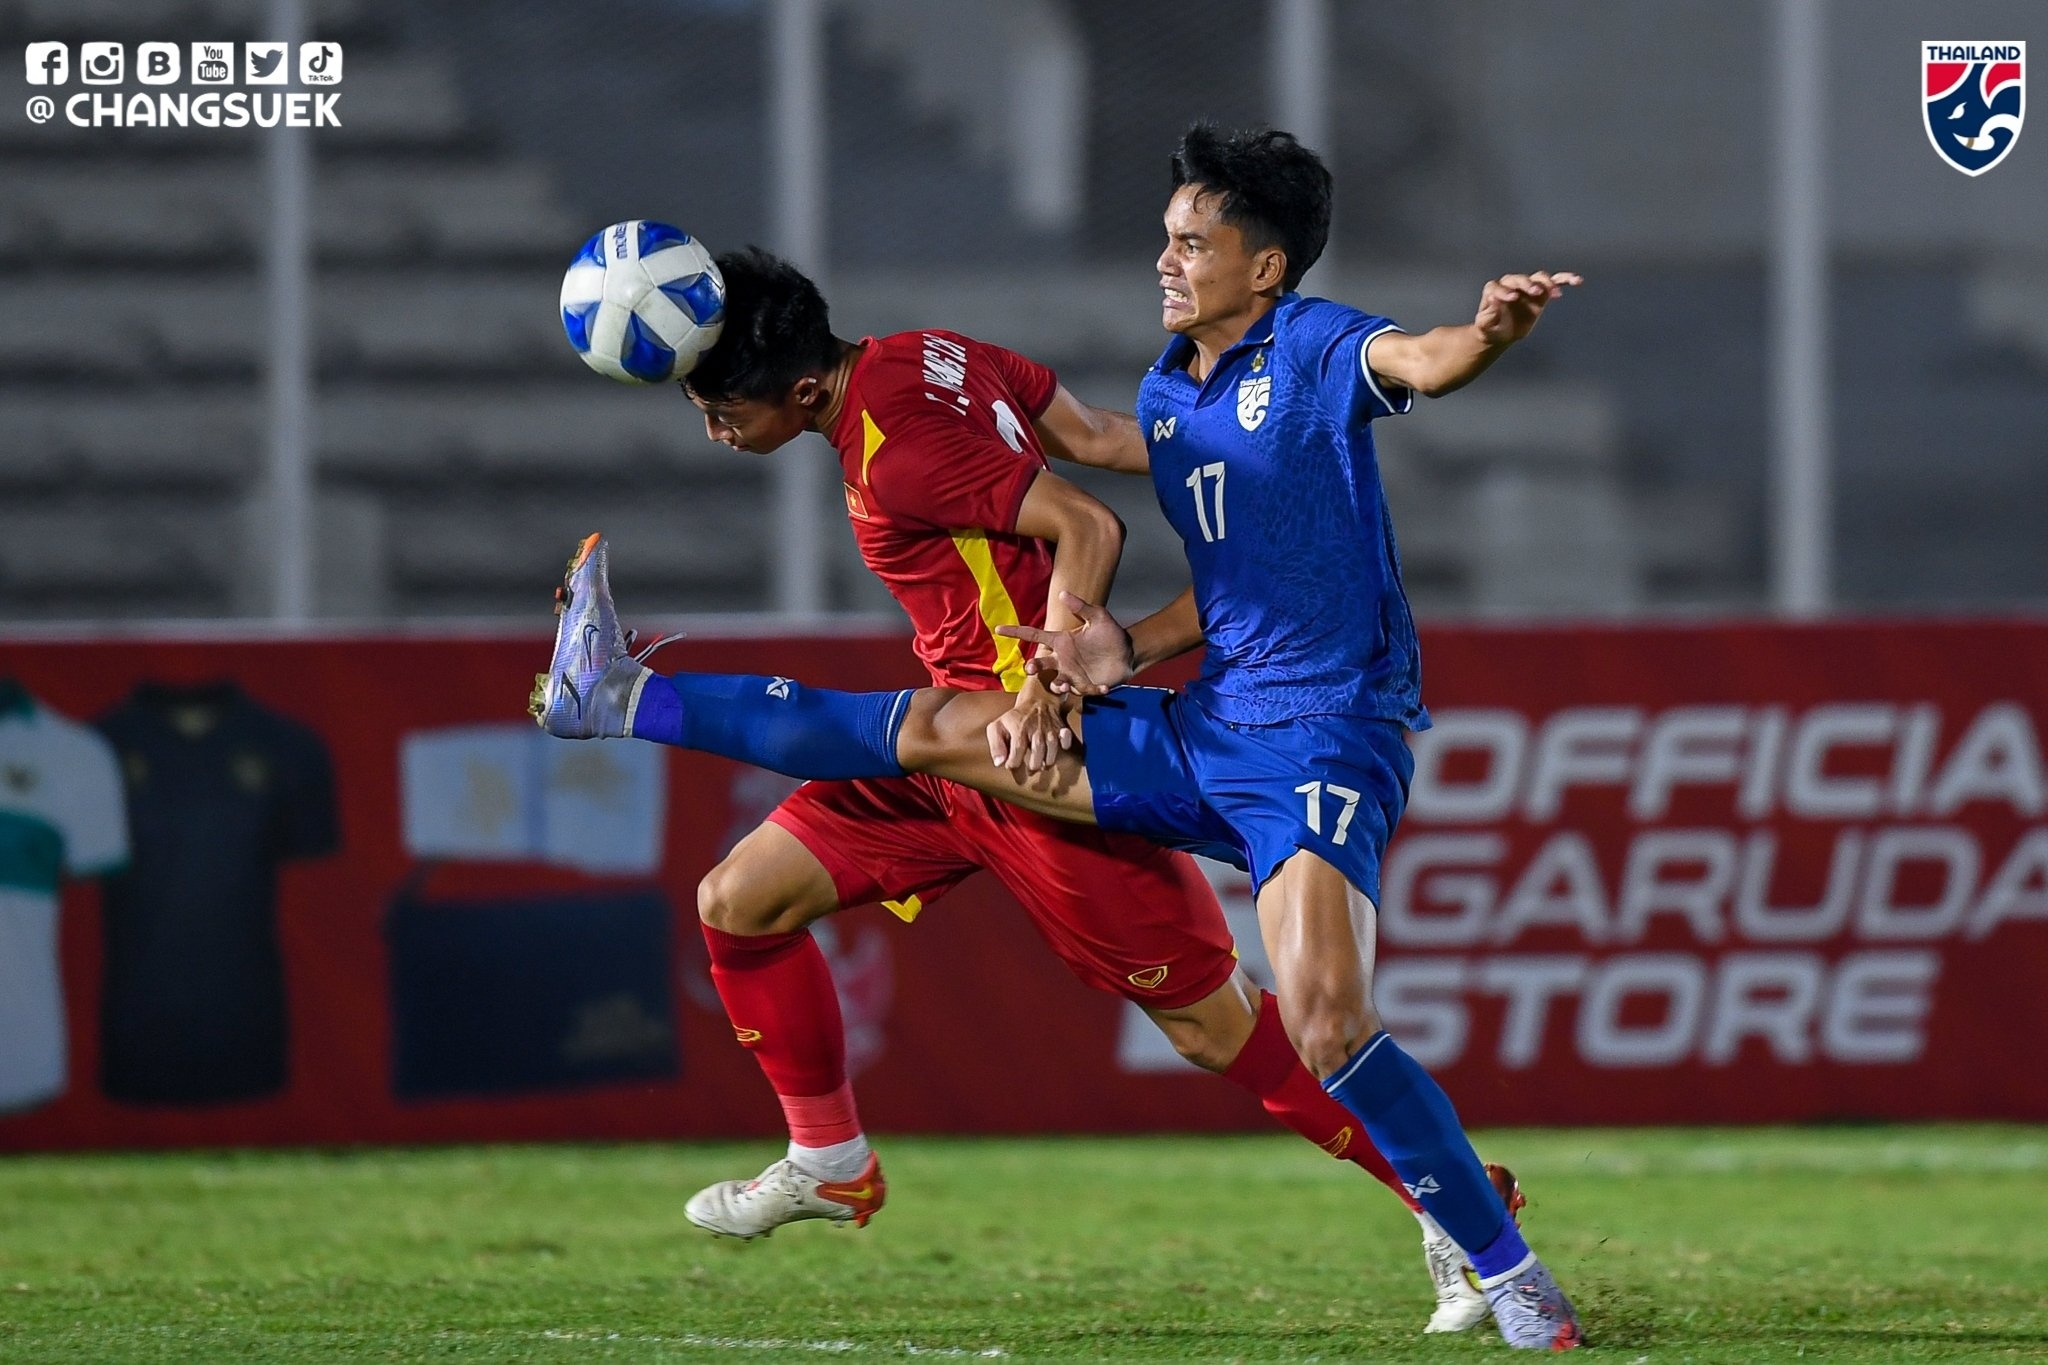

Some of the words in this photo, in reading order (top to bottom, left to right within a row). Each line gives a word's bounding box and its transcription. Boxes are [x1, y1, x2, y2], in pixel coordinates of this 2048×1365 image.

[1185, 461, 1226, 543] 17
[1294, 781, 1361, 846] 17
[1378, 825, 2048, 945] GARUDA
[1374, 951, 1943, 1070] STORE
